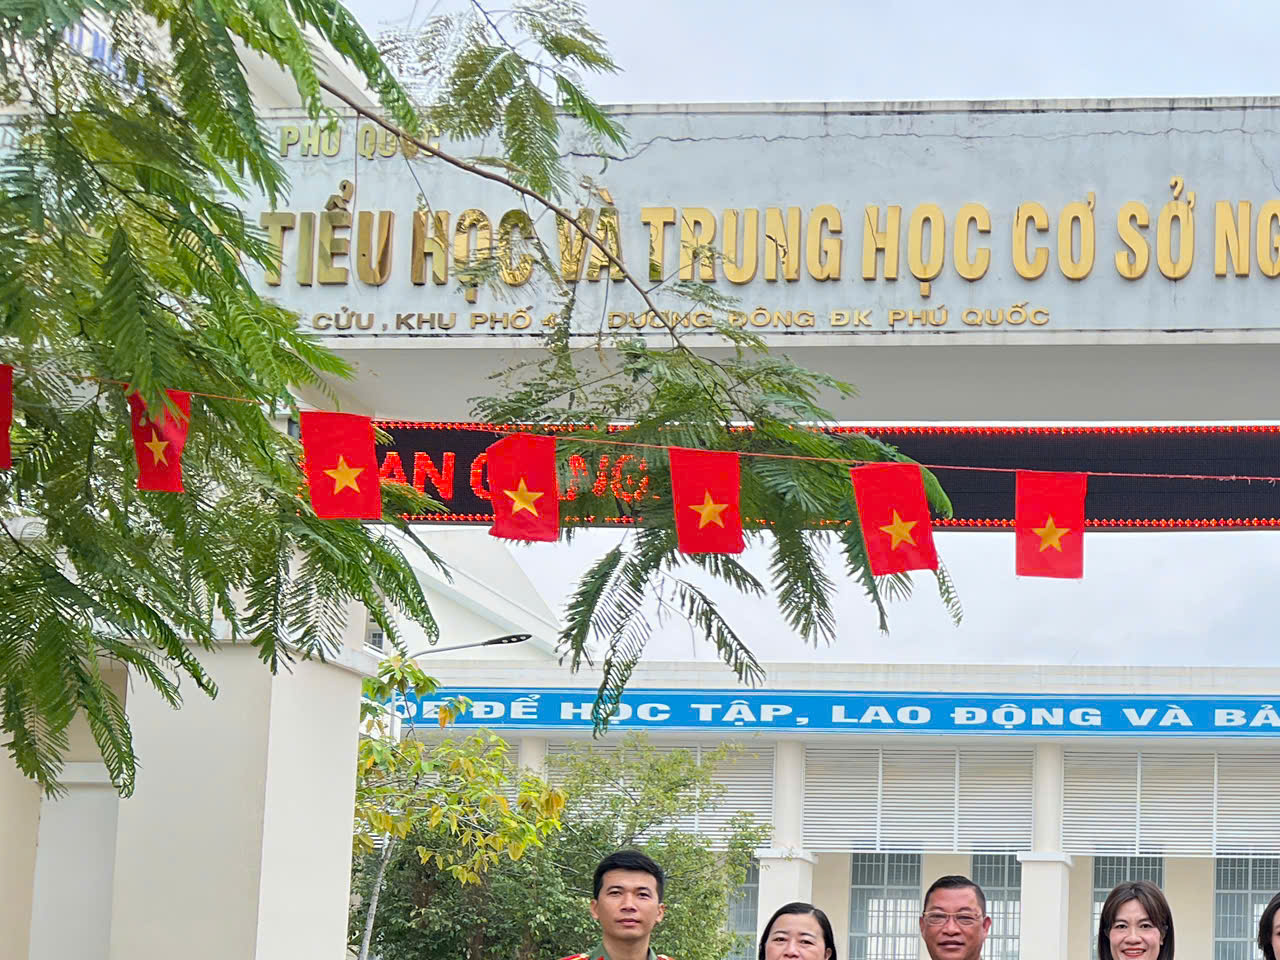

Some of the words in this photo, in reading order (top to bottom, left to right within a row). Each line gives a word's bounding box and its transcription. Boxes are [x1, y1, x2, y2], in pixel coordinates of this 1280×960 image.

[357, 124, 441, 160] QUC
[260, 180, 396, 287] TIỂU
[411, 207, 536, 304] HỌC
[554, 184, 627, 282] VÀ
[641, 204, 842, 285] TRUNG
[862, 203, 992, 297] HỌC
[1012, 191, 1096, 281] CƠ
[1115, 175, 1196, 281] SỞ
[396, 312, 457, 331] KHU
[470, 305, 534, 330] PHỐ
[728, 306, 817, 328] ĐÔNG
[888, 304, 949, 327] PHÚ
[961, 301, 1050, 327] QUỐC
[469, 694, 542, 720] ĐỂ
[560, 701, 672, 725] HỌC
[690, 699, 809, 726] TẬP,
[831, 705, 931, 726] LAO
[950, 703, 1102, 729] ĐỘNG
[1122, 703, 1194, 727] VÀ
